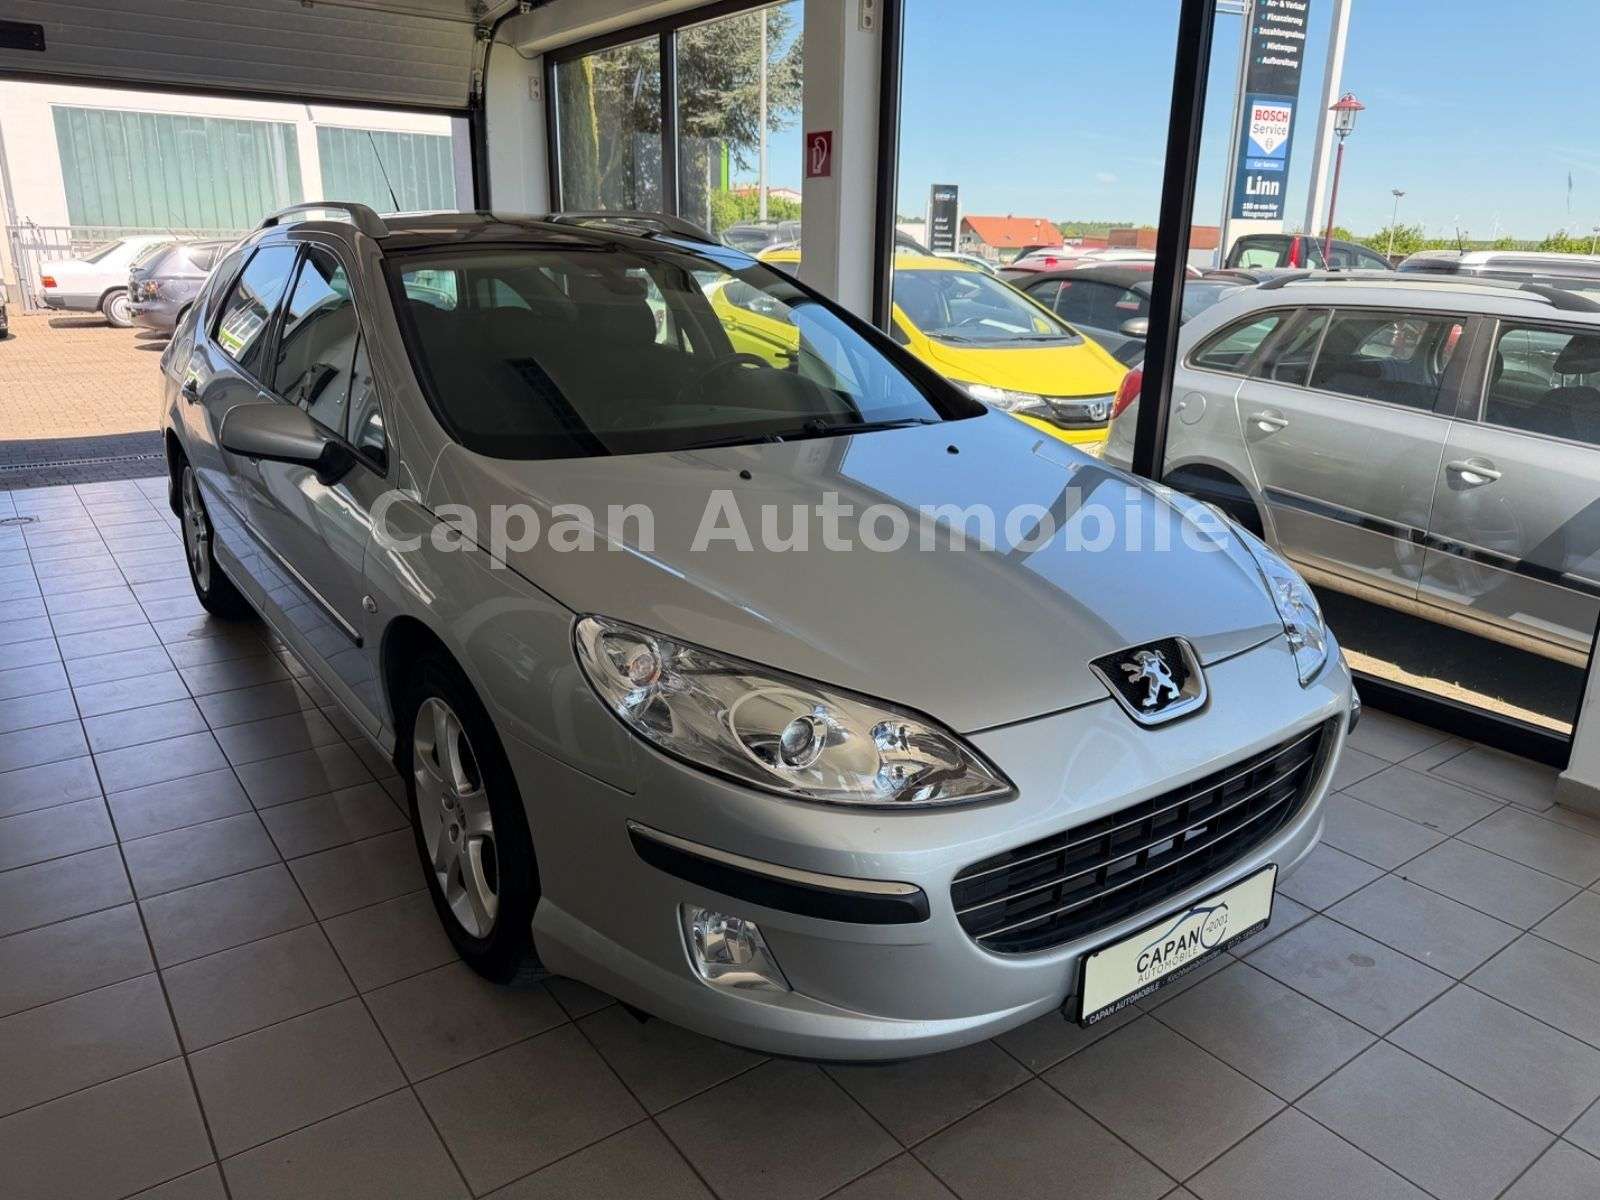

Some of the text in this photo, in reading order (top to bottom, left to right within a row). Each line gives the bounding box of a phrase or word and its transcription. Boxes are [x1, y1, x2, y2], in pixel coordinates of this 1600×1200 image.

[1267, 13, 1303, 26] Finanzierung
[1262, 57, 1298, 68] Aufbereitung
[1254, 109, 1289, 123] BOSCH
[1252, 123, 1287, 136] Service
[1245, 175, 1280, 196] Linn
[1136, 927, 1200, 974] CAPAN
[1137, 946, 1199, 984] AUTOMOBILE
[1089, 982, 1160, 1025] CAPAN AUTOMOBILE
